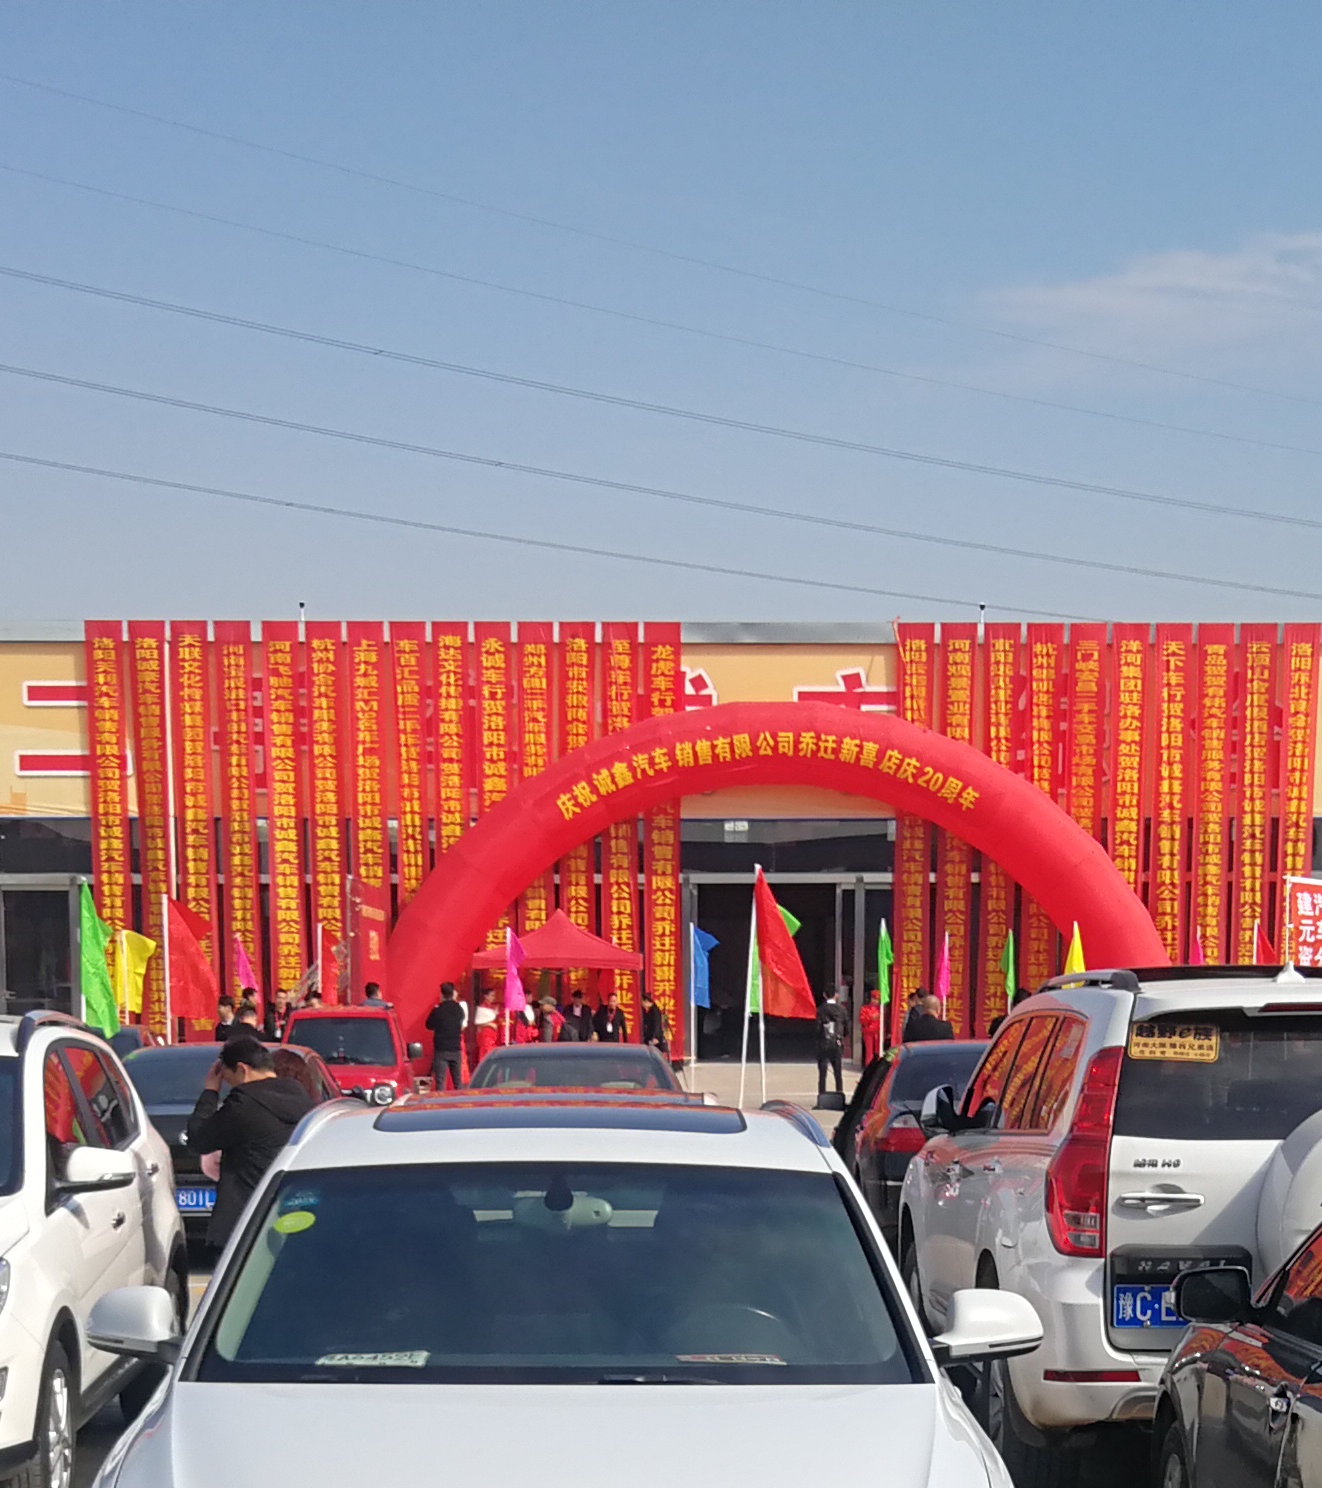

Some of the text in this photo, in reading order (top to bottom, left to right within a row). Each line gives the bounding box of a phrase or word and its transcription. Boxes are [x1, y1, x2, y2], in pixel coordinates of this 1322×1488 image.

[555, 730, 981, 823] 庆祝诚鑫汽车销售有限公司乔迁新喜店庆20周年
